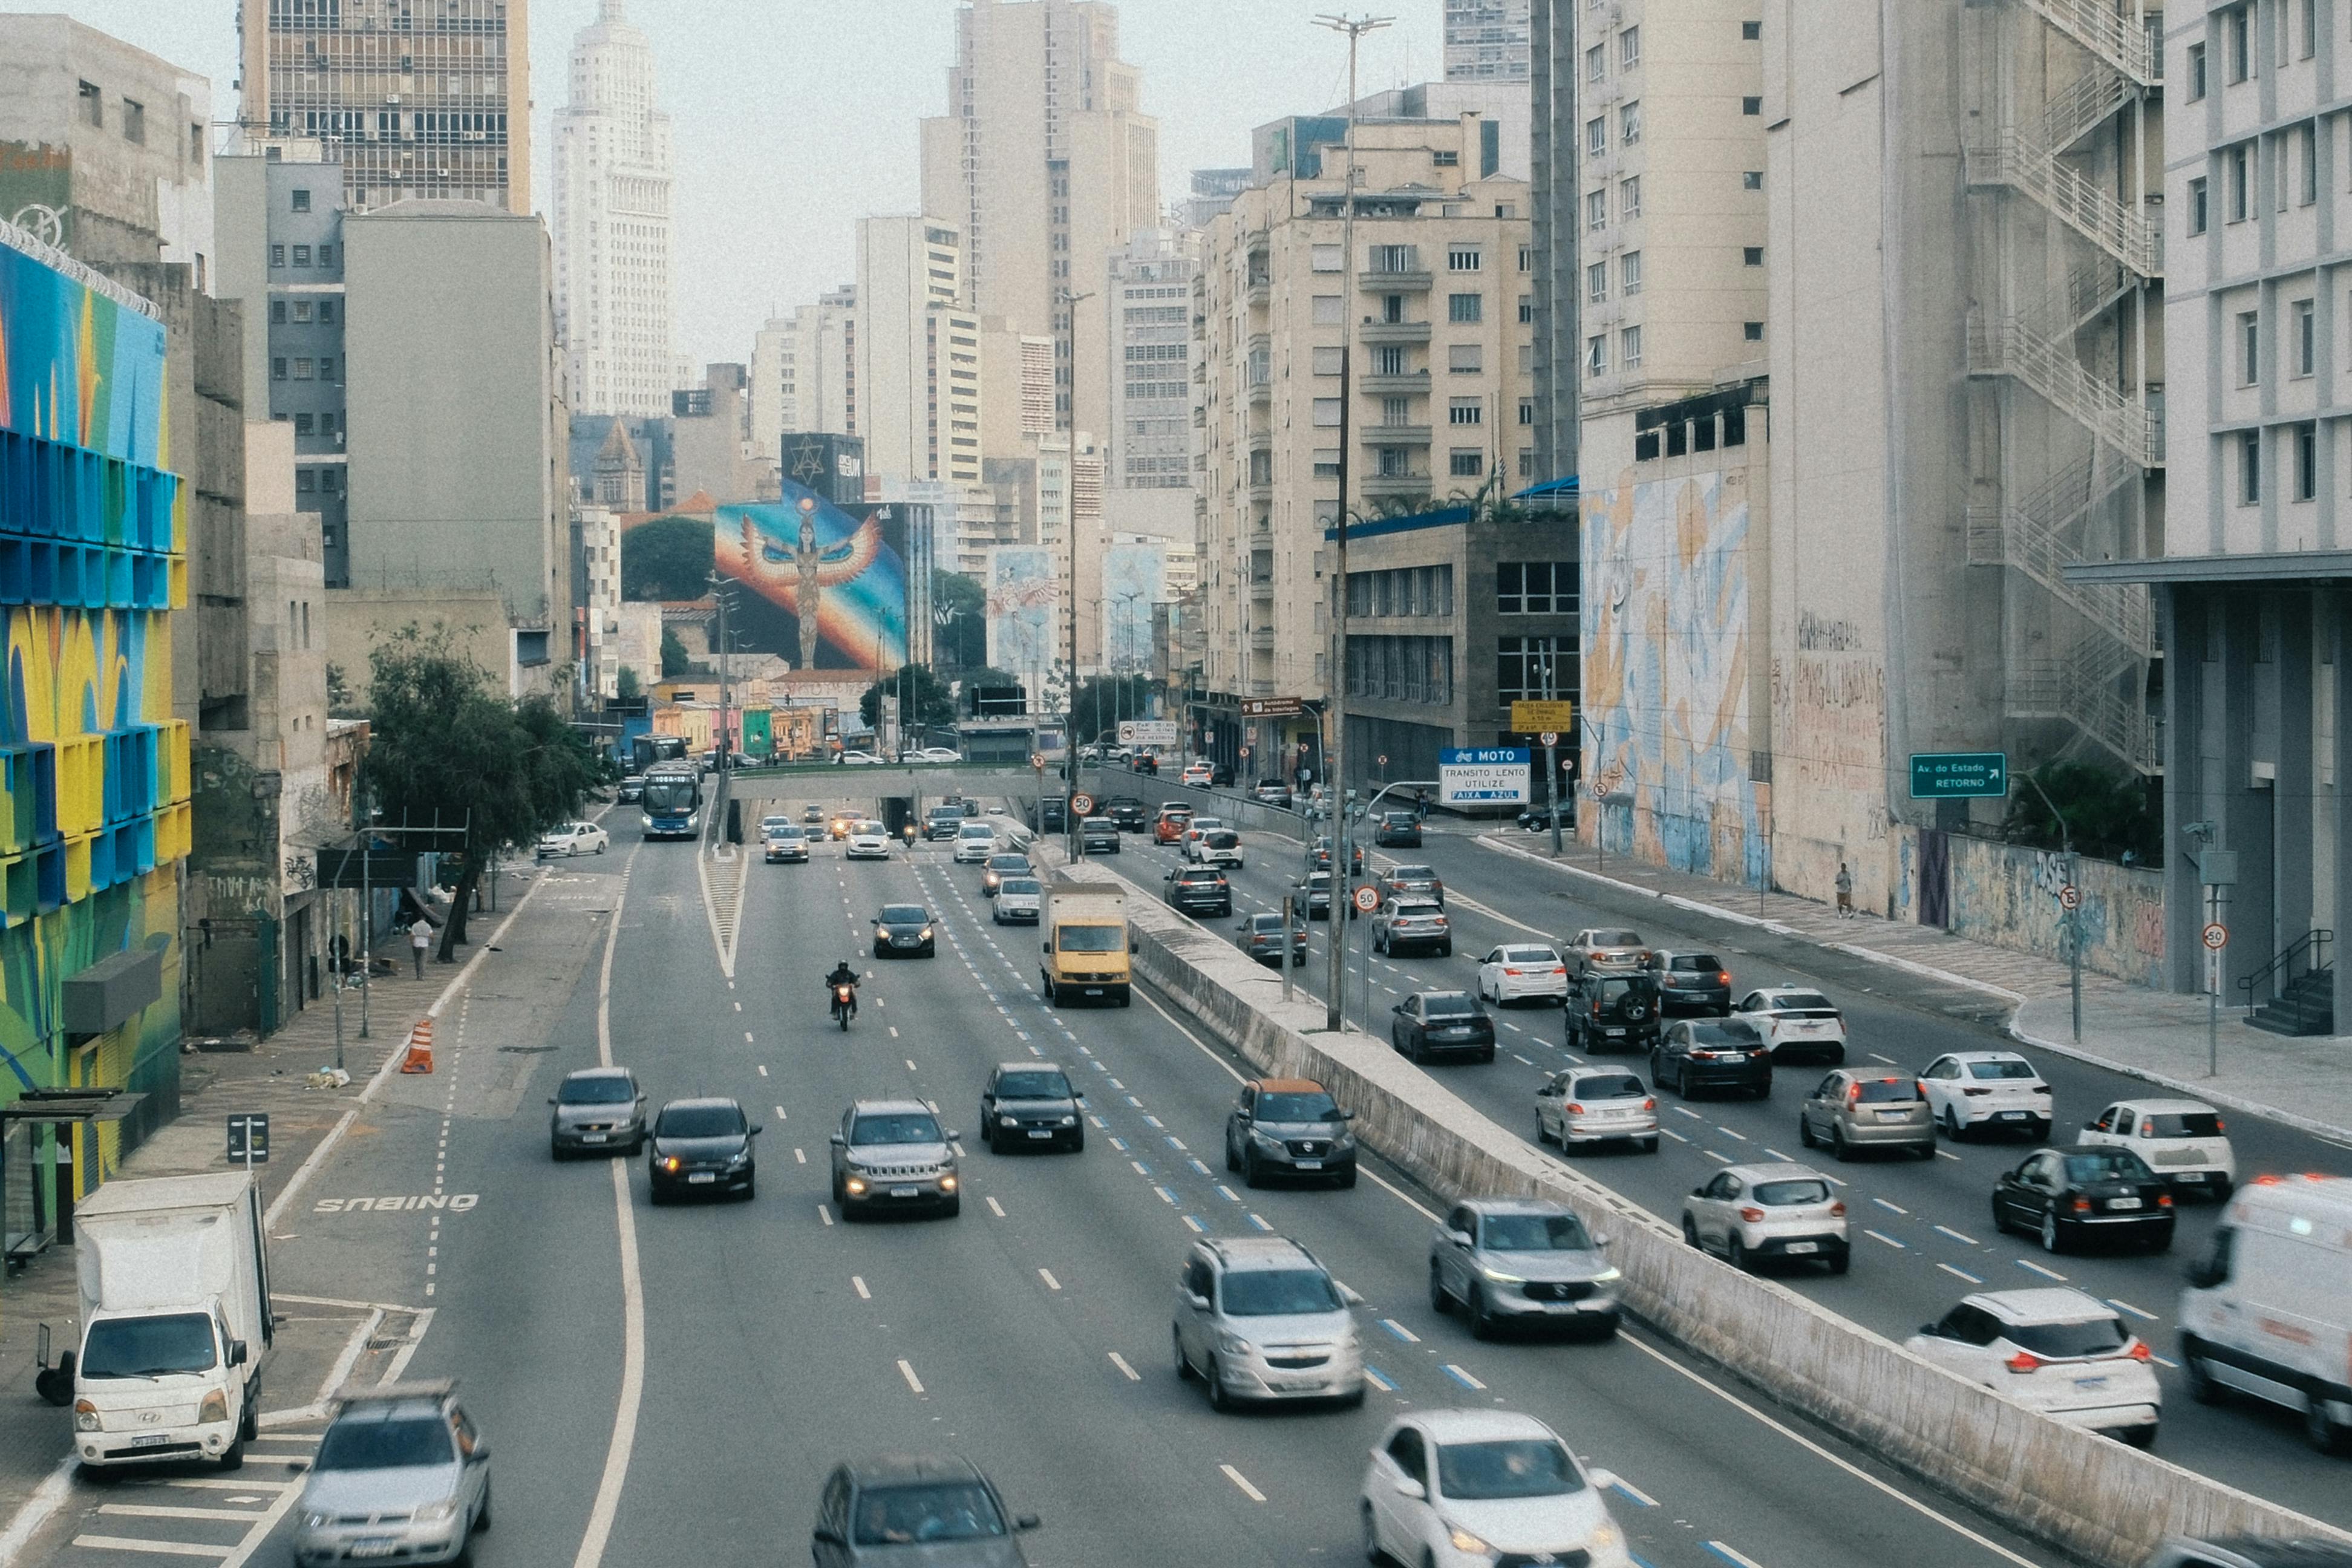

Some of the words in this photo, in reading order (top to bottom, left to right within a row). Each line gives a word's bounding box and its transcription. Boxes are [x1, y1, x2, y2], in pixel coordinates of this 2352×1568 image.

[1478, 751, 1515, 761] MOTO
[1918, 765, 1932, 773] Av.
[1936, 764, 1947, 773] do
[1952, 763, 1985, 773] Estado
[1936, 779, 1985, 788] RETORNO
[1490, 791, 1517, 799] AZUL
[1076, 797, 1090, 808] 50
[1360, 893, 1373, 903] 50
[2208, 931, 2222, 941] 50
